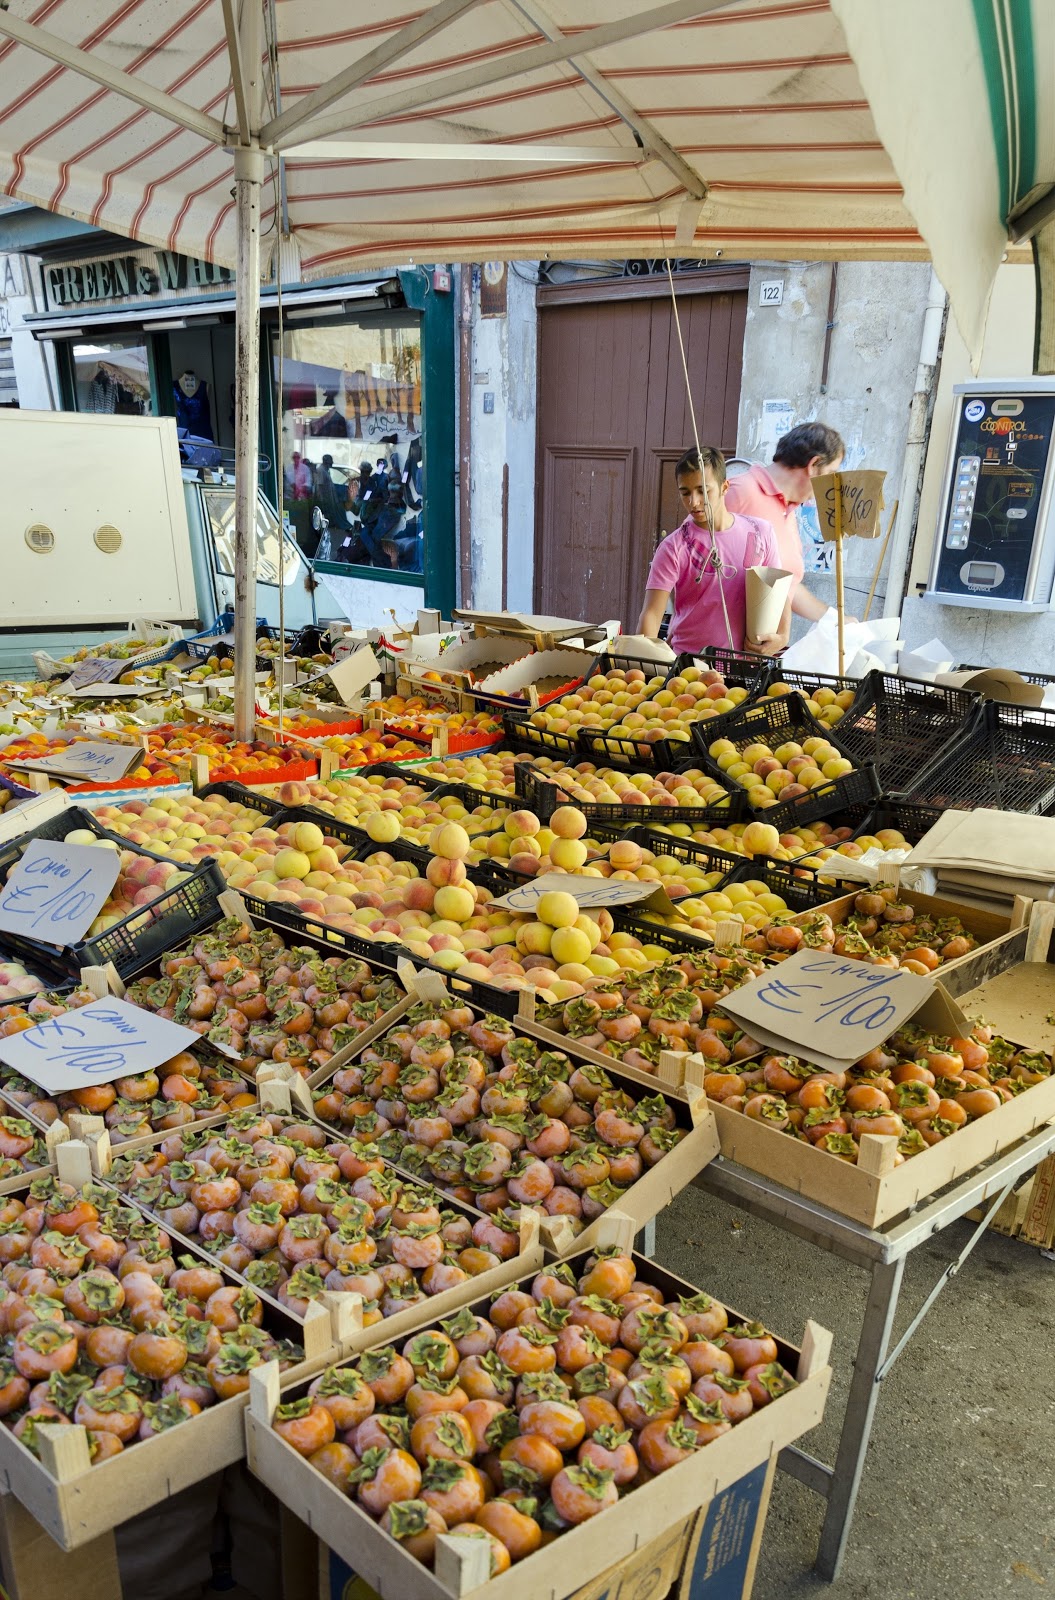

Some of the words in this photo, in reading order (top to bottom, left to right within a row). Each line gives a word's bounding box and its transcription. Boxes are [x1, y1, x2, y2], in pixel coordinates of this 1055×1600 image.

[46, 256, 137, 305] GREEN
[136, 266, 156, 295] &
[763, 286, 780, 300] 122
